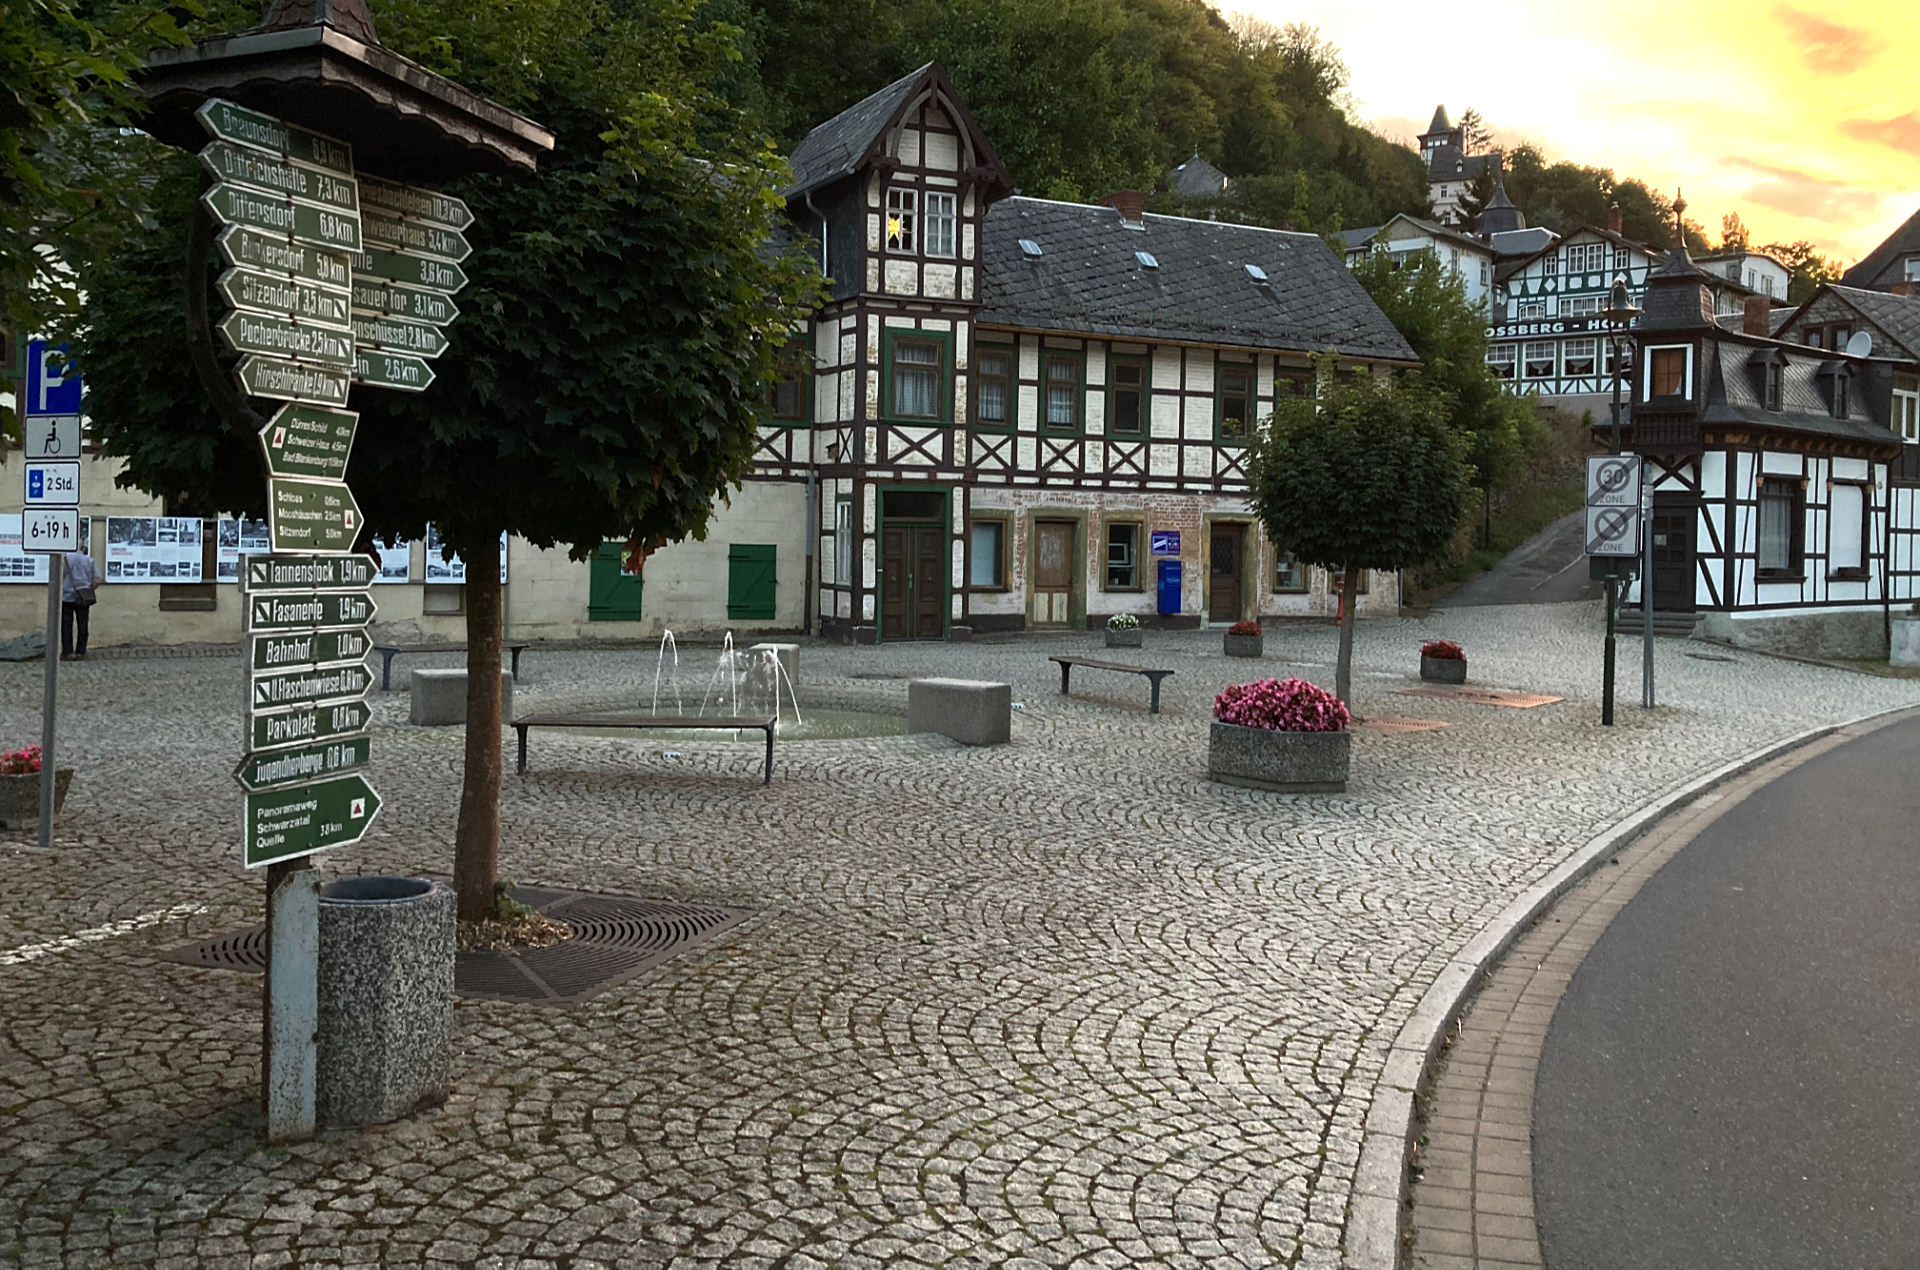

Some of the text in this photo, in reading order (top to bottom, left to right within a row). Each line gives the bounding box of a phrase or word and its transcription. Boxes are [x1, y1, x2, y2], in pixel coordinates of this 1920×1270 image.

[222, 107, 290, 151] Braunsdorf
[224, 149, 307, 193] Dittrichshütte
[228, 191, 295, 230] Dittersdorf
[242, 275, 301, 310] Sitzendorf
[318, 295, 333, 318] km
[389, 289, 407, 311] Tor
[351, 320, 407, 346] enschüssel
[1484, 322, 1565, 338] OSSBERG
[39, 350, 70, 410] P
[46, 476, 75, 491] 2 Std.
[1603, 469, 1623, 485] 30
[1600, 495, 1625, 504] ZONE
[31, 521, 70, 539] 6-19 h
[1598, 543, 1624, 552] ZONE
[270, 560, 334, 584] Tannenstock
[272, 598, 324, 622] Fasanerie
[266, 637, 311, 664] Bahnhof
[267, 713, 316, 741] Parkplatz
[341, 744, 355, 767] km
[257, 800, 318, 819] Panoramaweg
[257, 814, 310, 834] Schwarzatal
[256, 834, 285, 849] Quelle
